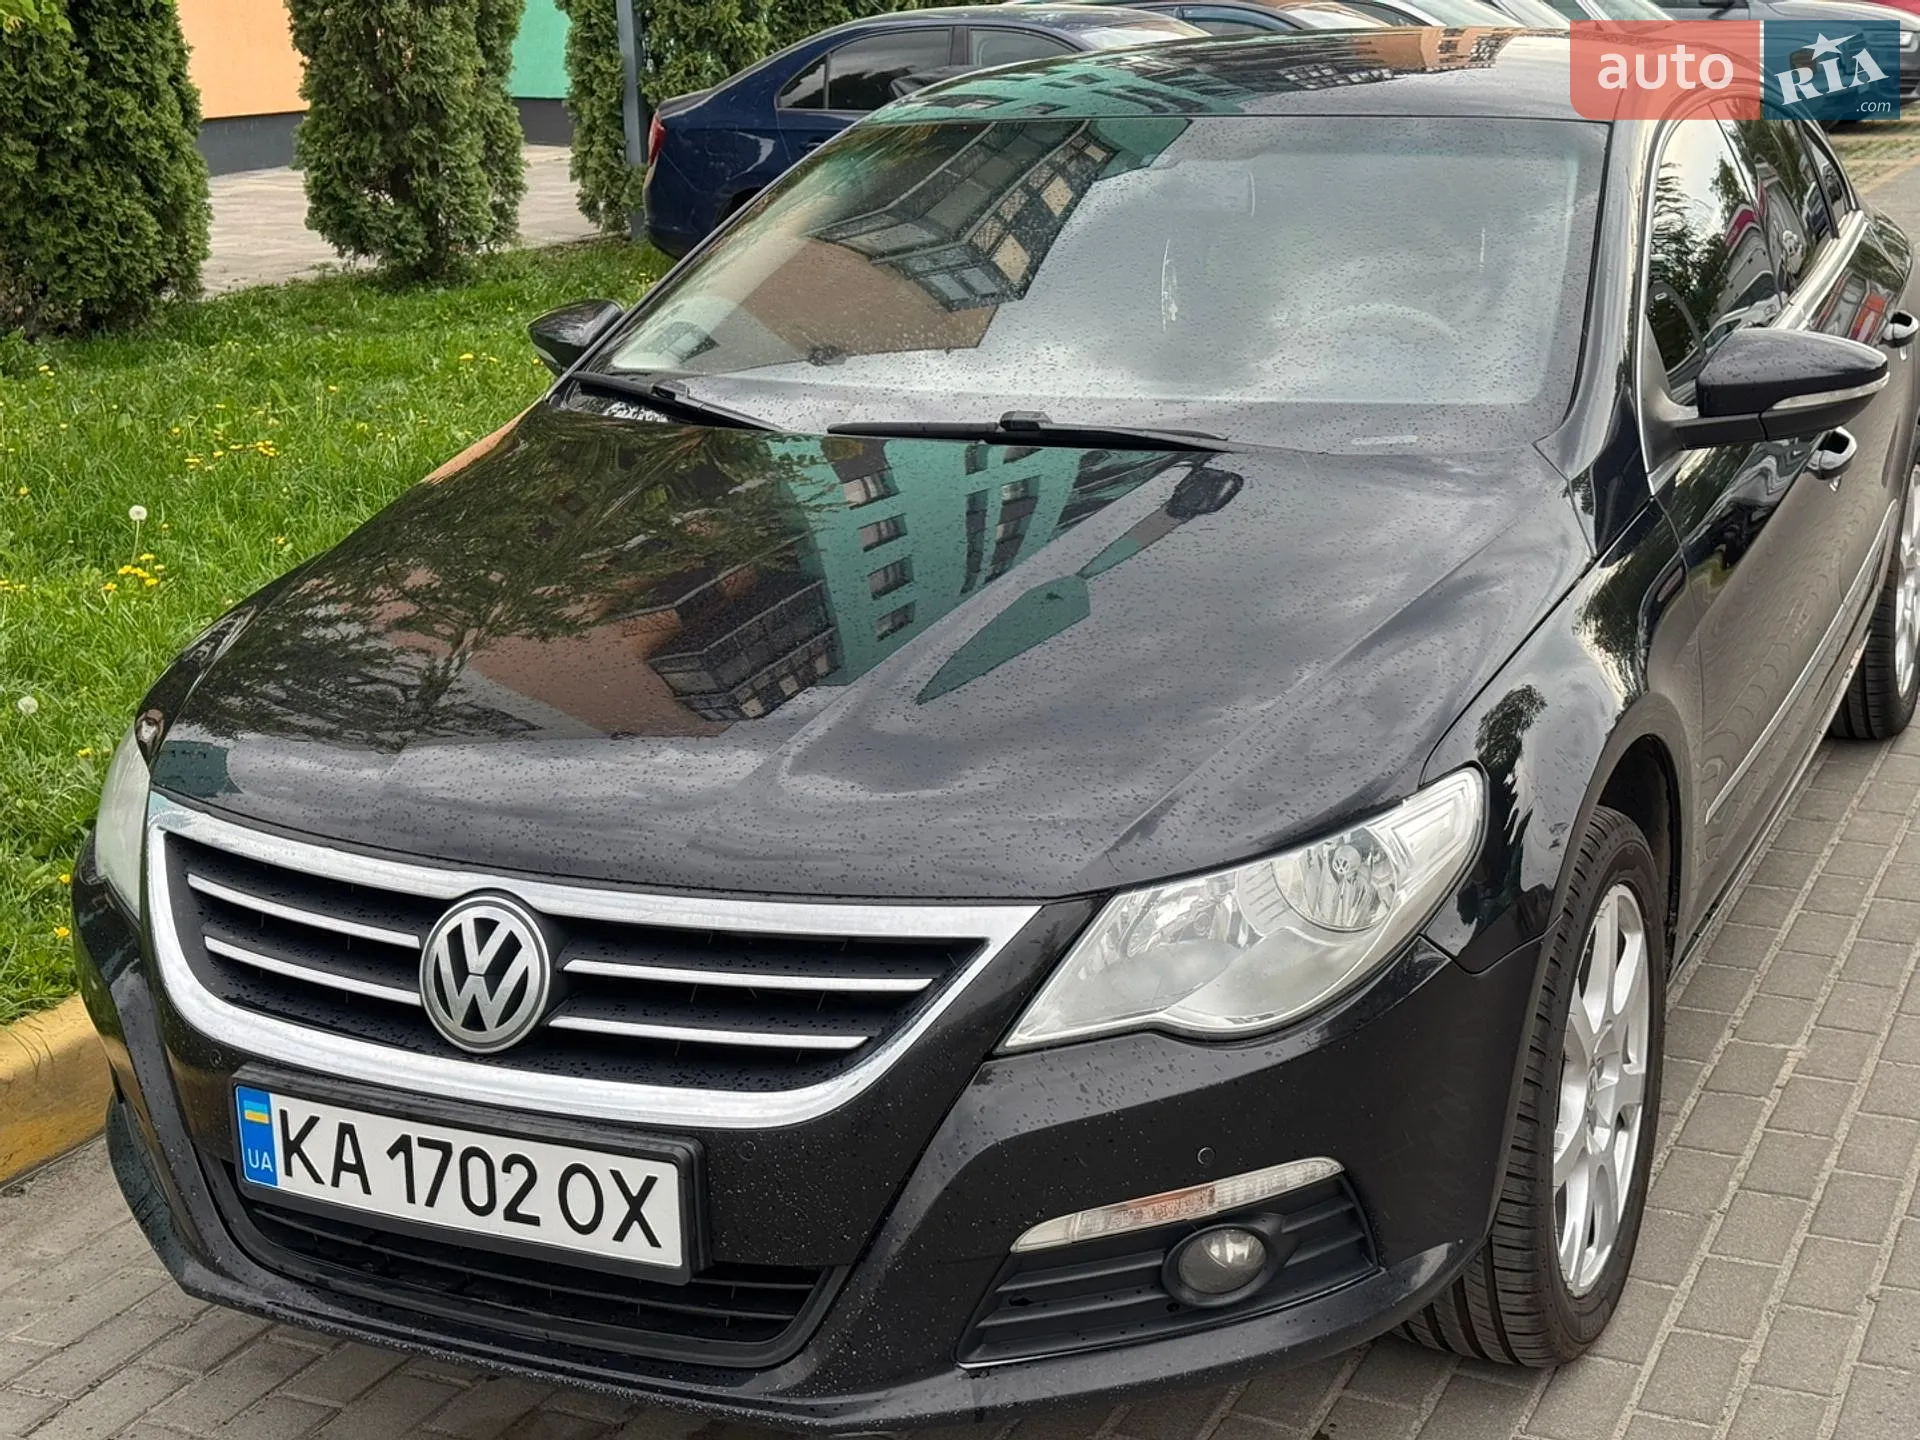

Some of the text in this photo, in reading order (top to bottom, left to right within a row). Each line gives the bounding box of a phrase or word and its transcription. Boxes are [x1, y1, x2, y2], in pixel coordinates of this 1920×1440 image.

[431, 906, 532, 1041] VW
[247, 1147, 273, 1173] UA
[279, 1108, 662, 1248] KA 1702 OX
